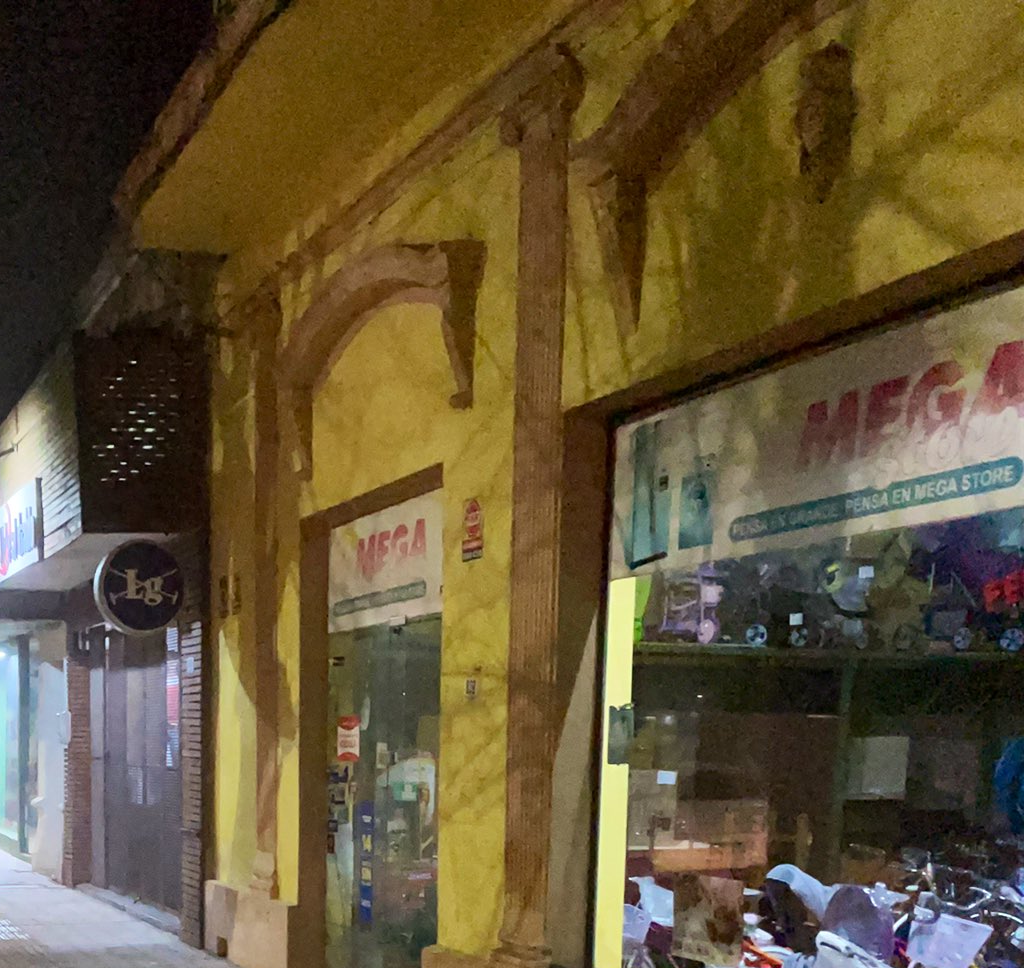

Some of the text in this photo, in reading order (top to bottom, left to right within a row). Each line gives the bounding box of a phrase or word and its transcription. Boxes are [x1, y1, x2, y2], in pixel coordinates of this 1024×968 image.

[797, 340, 1024, 470] MEGA
[892, 487, 911, 503] EN
[914, 477, 958, 500] MEGA
[961, 465, 1014, 491] STORE
[356, 518, 426, 580] MEGA
